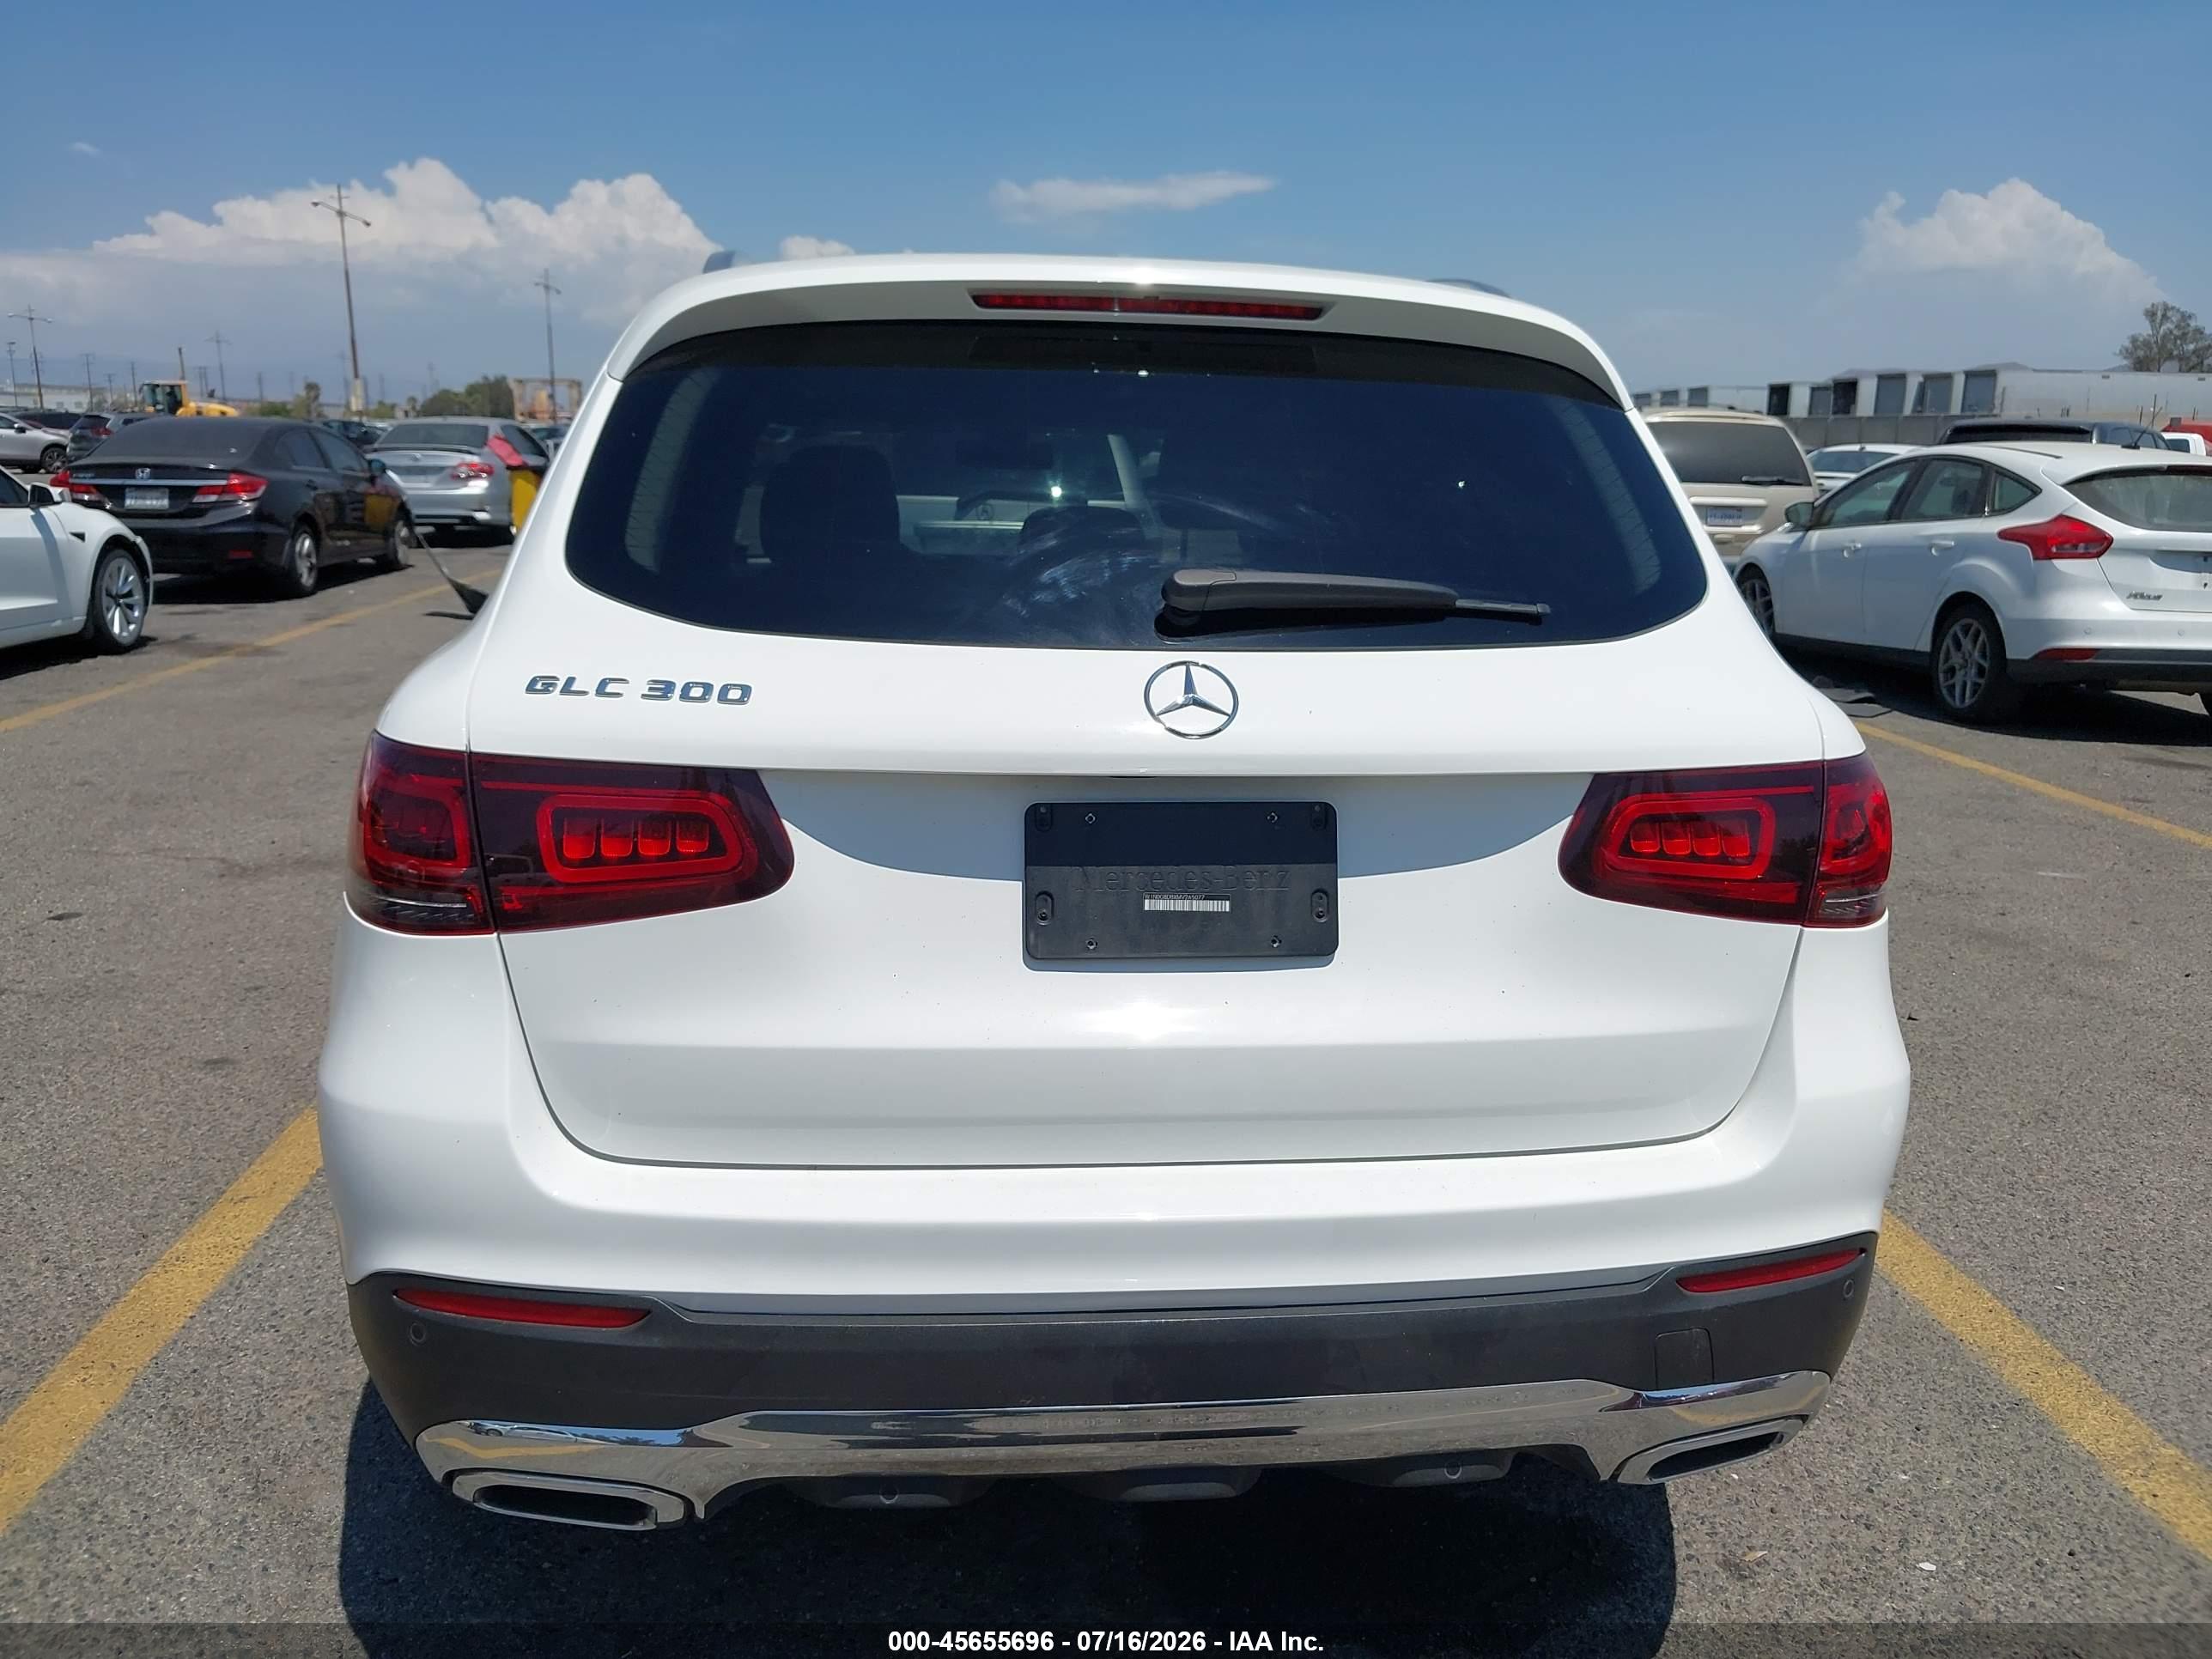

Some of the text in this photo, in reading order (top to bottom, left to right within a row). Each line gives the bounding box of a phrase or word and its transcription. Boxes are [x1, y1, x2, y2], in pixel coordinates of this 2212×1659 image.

[525, 675, 752, 706] GLC 300
[1073, 866, 1291, 892] Mercedes-Benz
